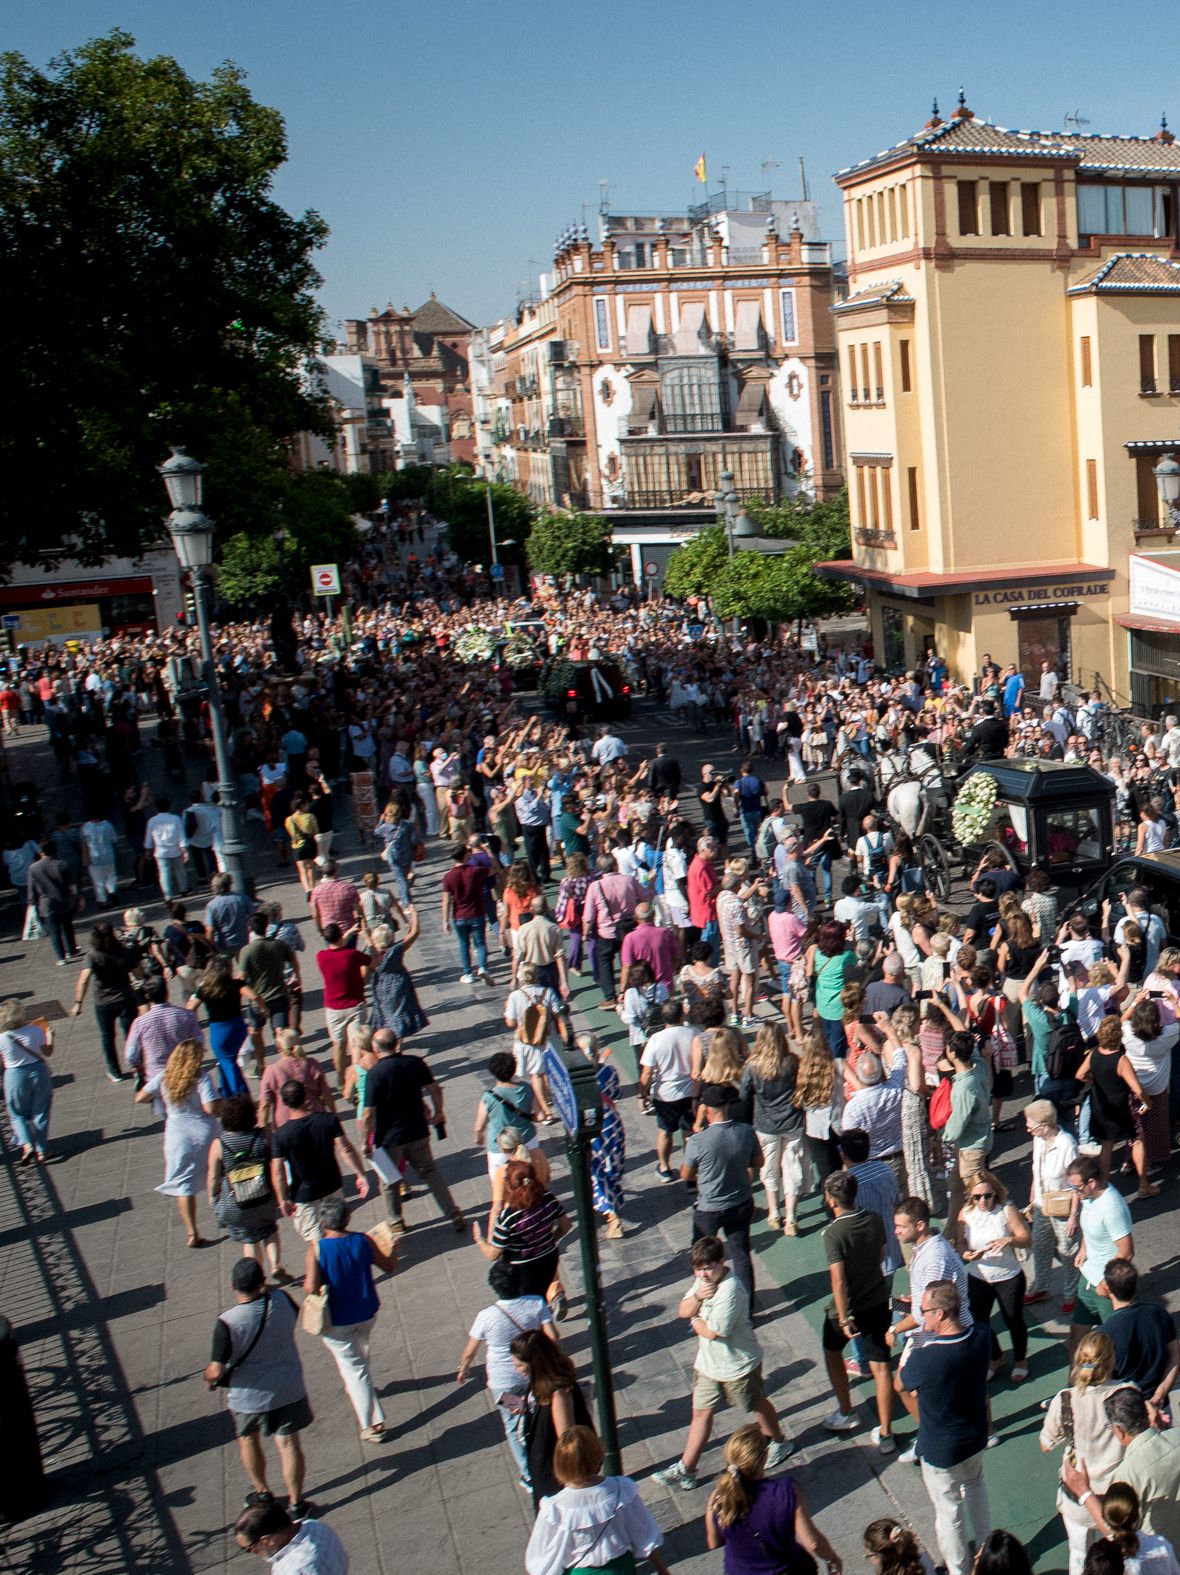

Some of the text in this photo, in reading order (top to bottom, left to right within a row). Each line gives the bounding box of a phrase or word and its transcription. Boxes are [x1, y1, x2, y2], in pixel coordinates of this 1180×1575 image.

[56, 585, 109, 598] Santander
[974, 584, 1109, 605] LA CASA DEL COFRADE
